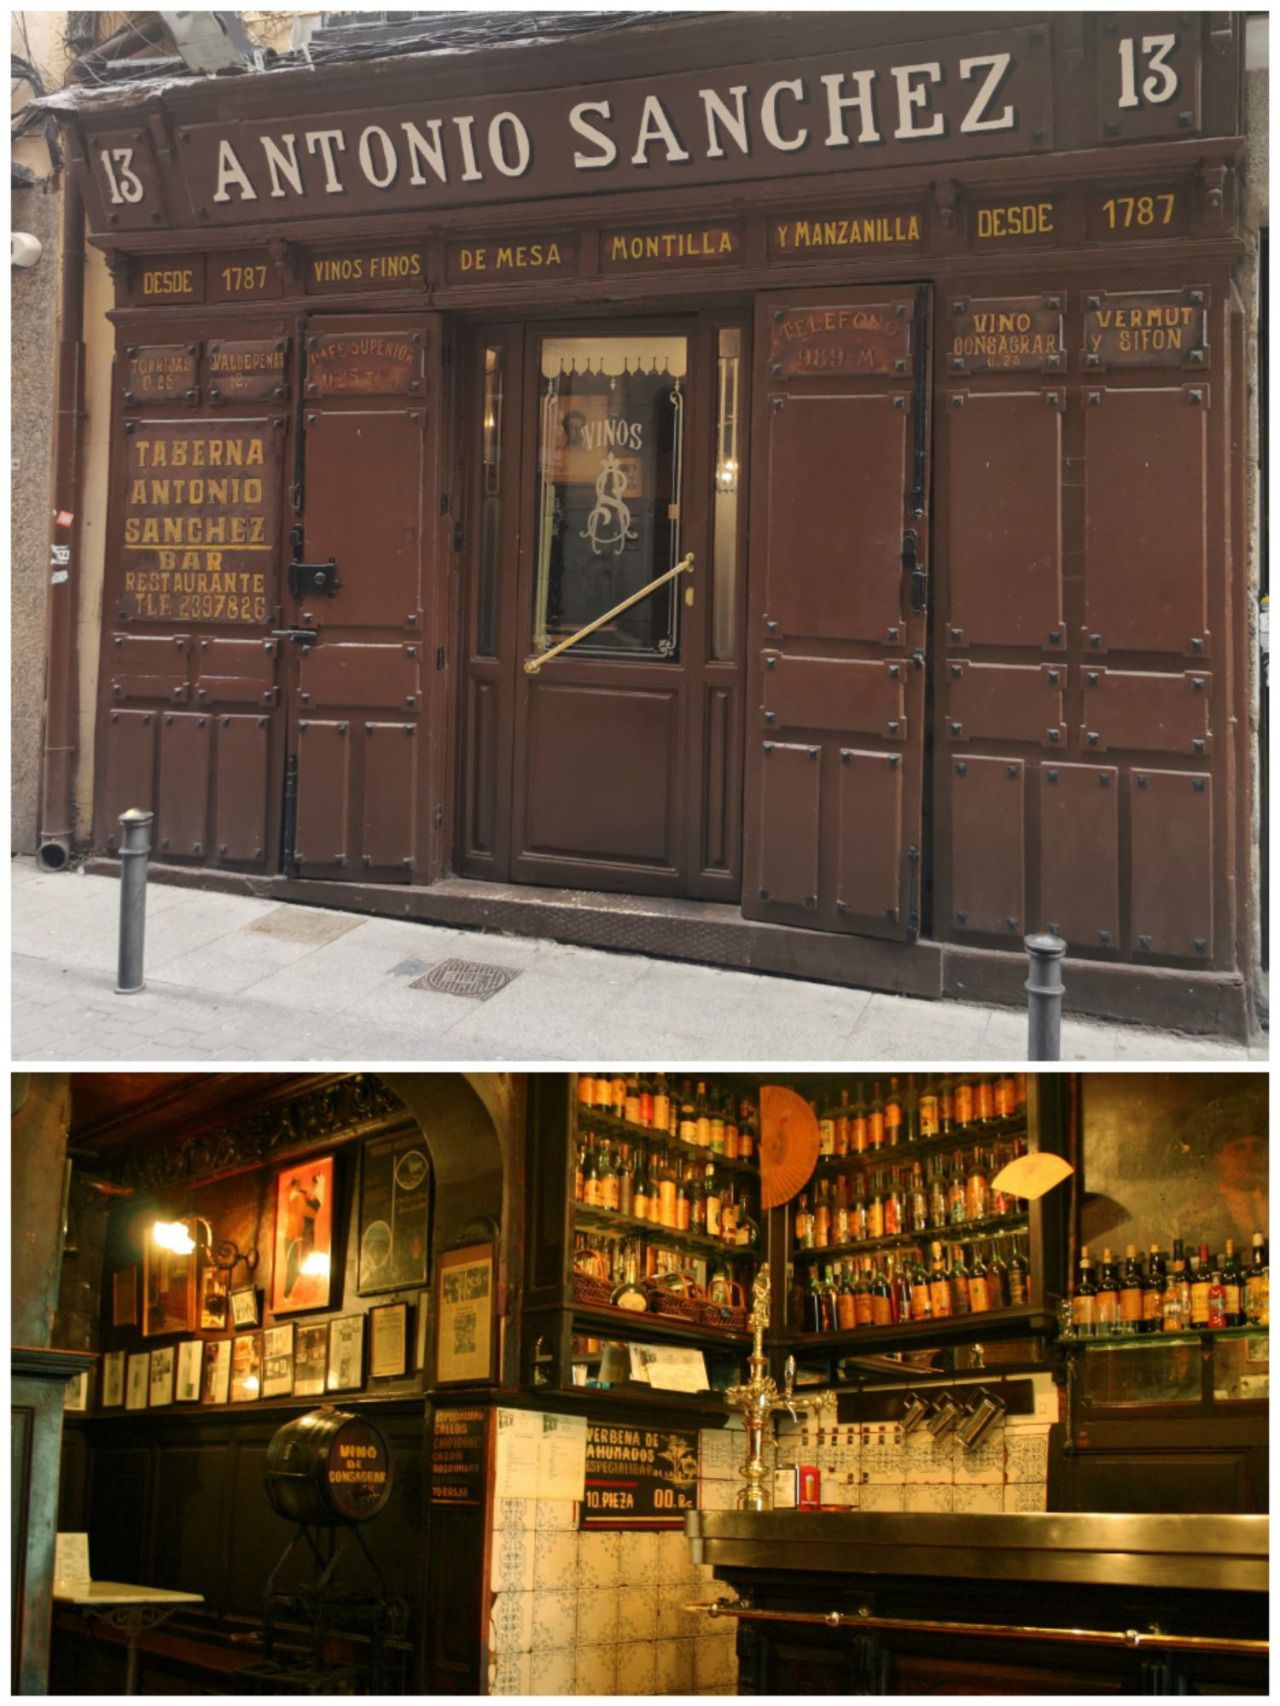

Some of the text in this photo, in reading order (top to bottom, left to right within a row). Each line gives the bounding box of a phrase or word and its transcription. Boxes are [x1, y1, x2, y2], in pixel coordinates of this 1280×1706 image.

[1118, 33, 1179, 108] 13
[213, 52, 1015, 202] ANTONIO SANCHEZ
[100, 147, 144, 204] 13
[977, 203, 1054, 239] DESDE
[1102, 194, 1176, 231] 1787
[776, 215, 920, 248] Y MANZANILLA
[461, 243, 562, 271] DE MESA
[611, 230, 733, 262] MONTILLA
[143, 269, 193, 295] DESDE
[221, 265, 267, 291] 1787
[313, 253, 421, 283] VINOS FINOS
[973, 312, 1031, 333] VINO
[1096, 307, 1193, 328] VERMUT
[1119, 329, 1183, 351] SIFON
[580, 419, 643, 450] VINOS
[135, 438, 264, 468] TABERNA
[131, 478, 263, 505] ANTONIO
[124, 516, 266, 544] SANCHEZ
[158, 551, 223, 572] BAR
[125, 572, 265, 594] RESTAURANTE
[340, 1444, 377, 1458] VINO
[586, 1427, 659, 1447] VERBENA DE
